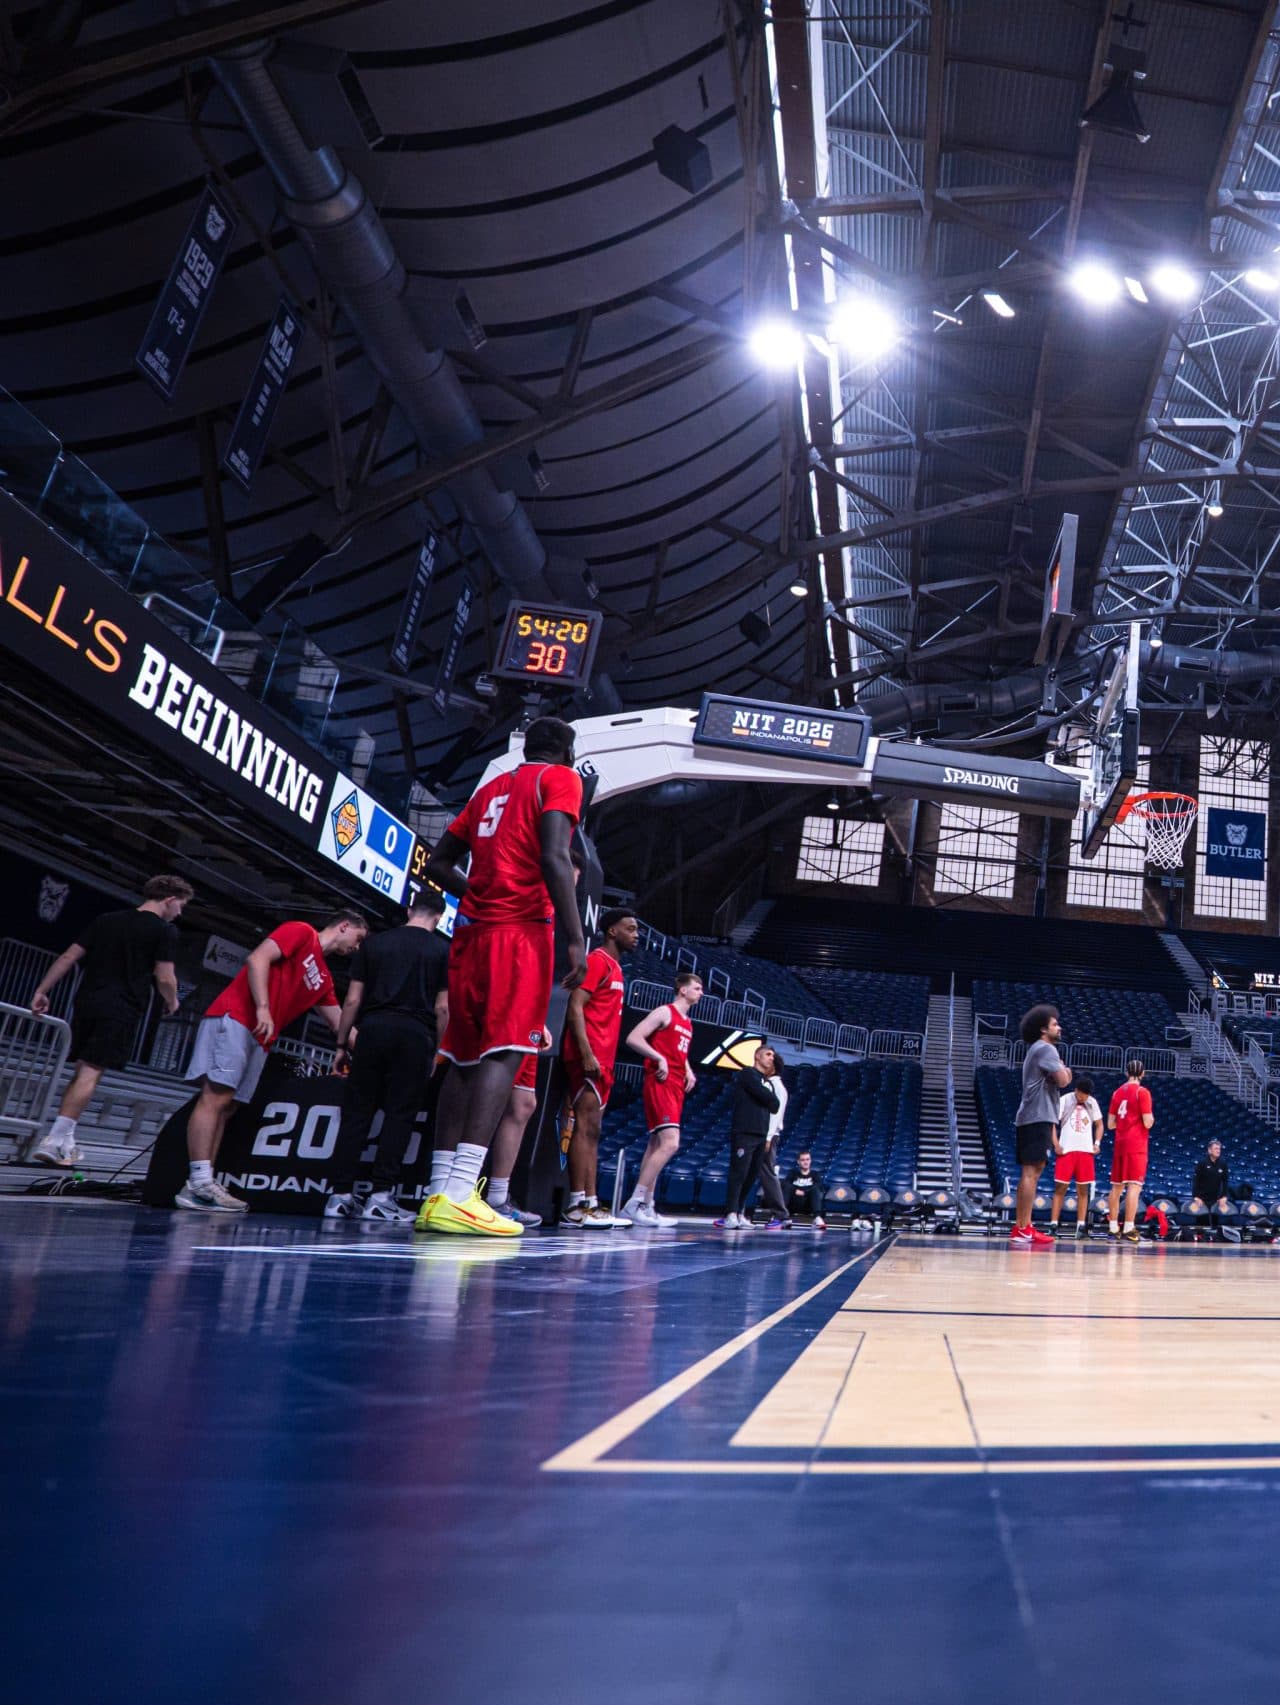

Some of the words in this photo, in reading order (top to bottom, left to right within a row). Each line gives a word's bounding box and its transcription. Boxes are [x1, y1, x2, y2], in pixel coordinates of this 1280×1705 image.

[183, 237, 215, 289] 1929
[518, 614, 588, 644] 54:20
[525, 641, 567, 673] 30
[0, 556, 128, 673] LL'S
[129, 643, 324, 824] BEGINNING
[732, 710, 776, 730] NIT
[782, 717, 834, 741] 2026
[750, 730, 812, 745] INDIANAPOLIS
[943, 767, 1020, 794] SPALDING
[477, 794, 510, 838] 5
[384, 824, 398, 855] 0
[1209, 844, 1263, 860] BUTLER
[1254, 973, 1275, 985] NIT
[902, 1039, 920, 1050] 204
[982, 1050, 999, 1060] 205
[1117, 1099, 1128, 1119] 4
